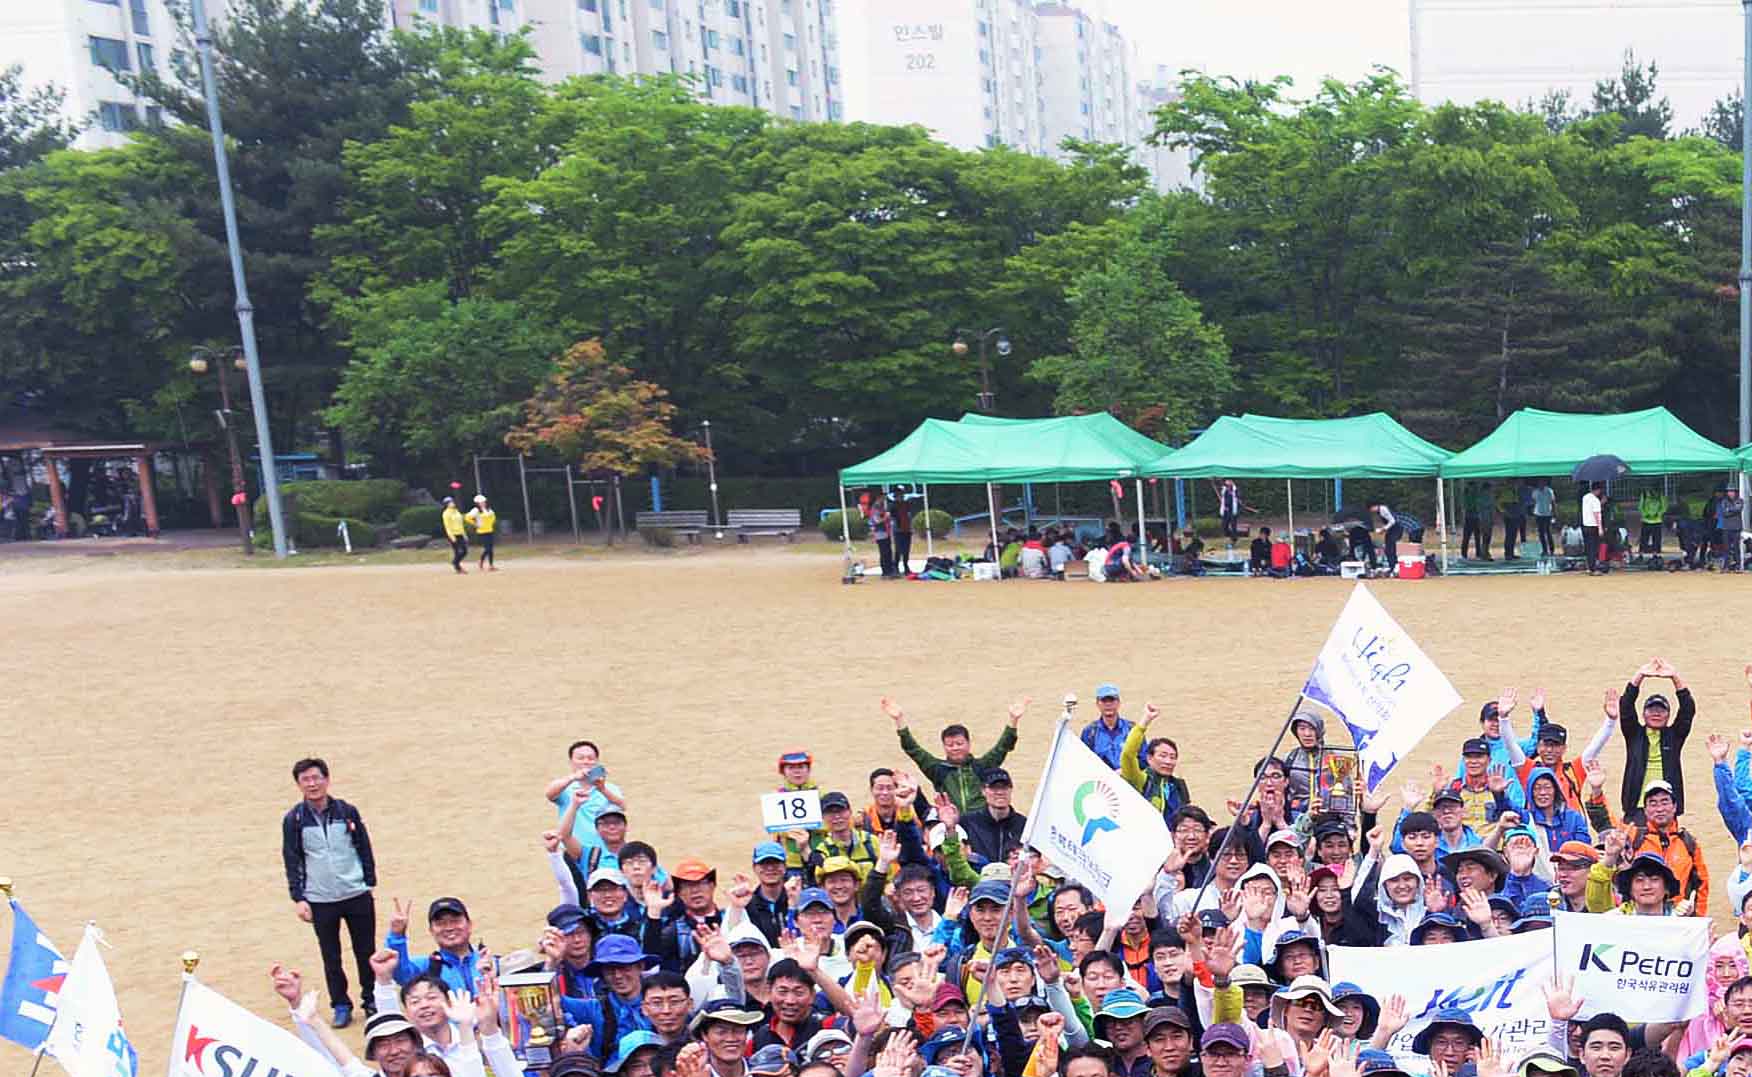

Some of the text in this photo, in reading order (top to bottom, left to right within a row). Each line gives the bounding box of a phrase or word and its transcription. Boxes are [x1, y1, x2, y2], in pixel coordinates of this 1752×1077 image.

[904, 53, 937, 71] 202
[777, 797, 807, 820] 18
[1620, 950, 1694, 979] Petro
[1615, 977, 1691, 995] 한국석유관리원
